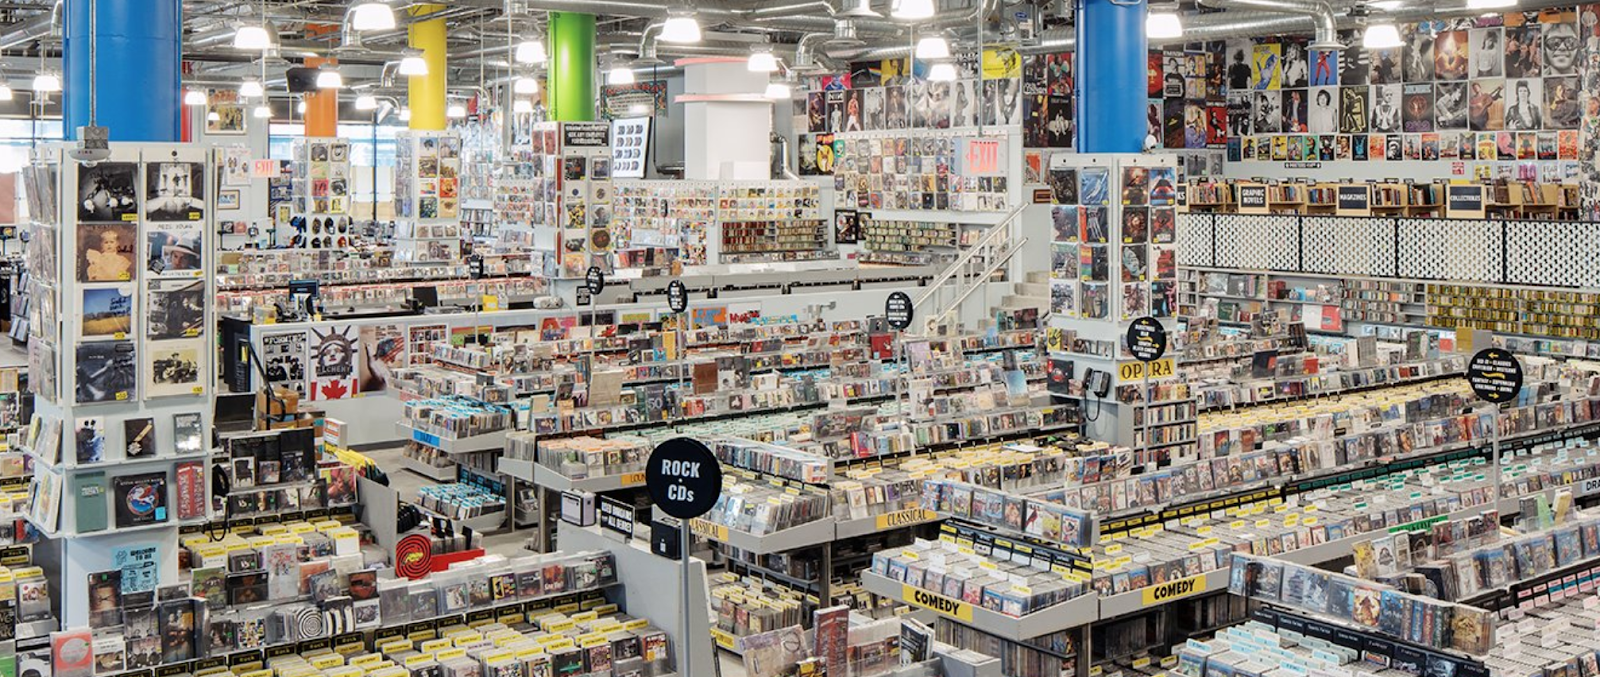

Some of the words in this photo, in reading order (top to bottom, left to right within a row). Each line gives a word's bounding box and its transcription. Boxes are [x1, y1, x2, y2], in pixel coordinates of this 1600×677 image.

[970, 141, 998, 174] EXIT
[255, 161, 274, 174] EXIT
[1242, 188, 1264, 197] GRAPHIC
[661, 458, 700, 478] ROCK
[668, 484, 695, 502] CDs
[887, 509, 927, 527] CLASSICAL
[1154, 579, 1195, 600] COMEDY
[914, 590, 959, 615] COMEDY
